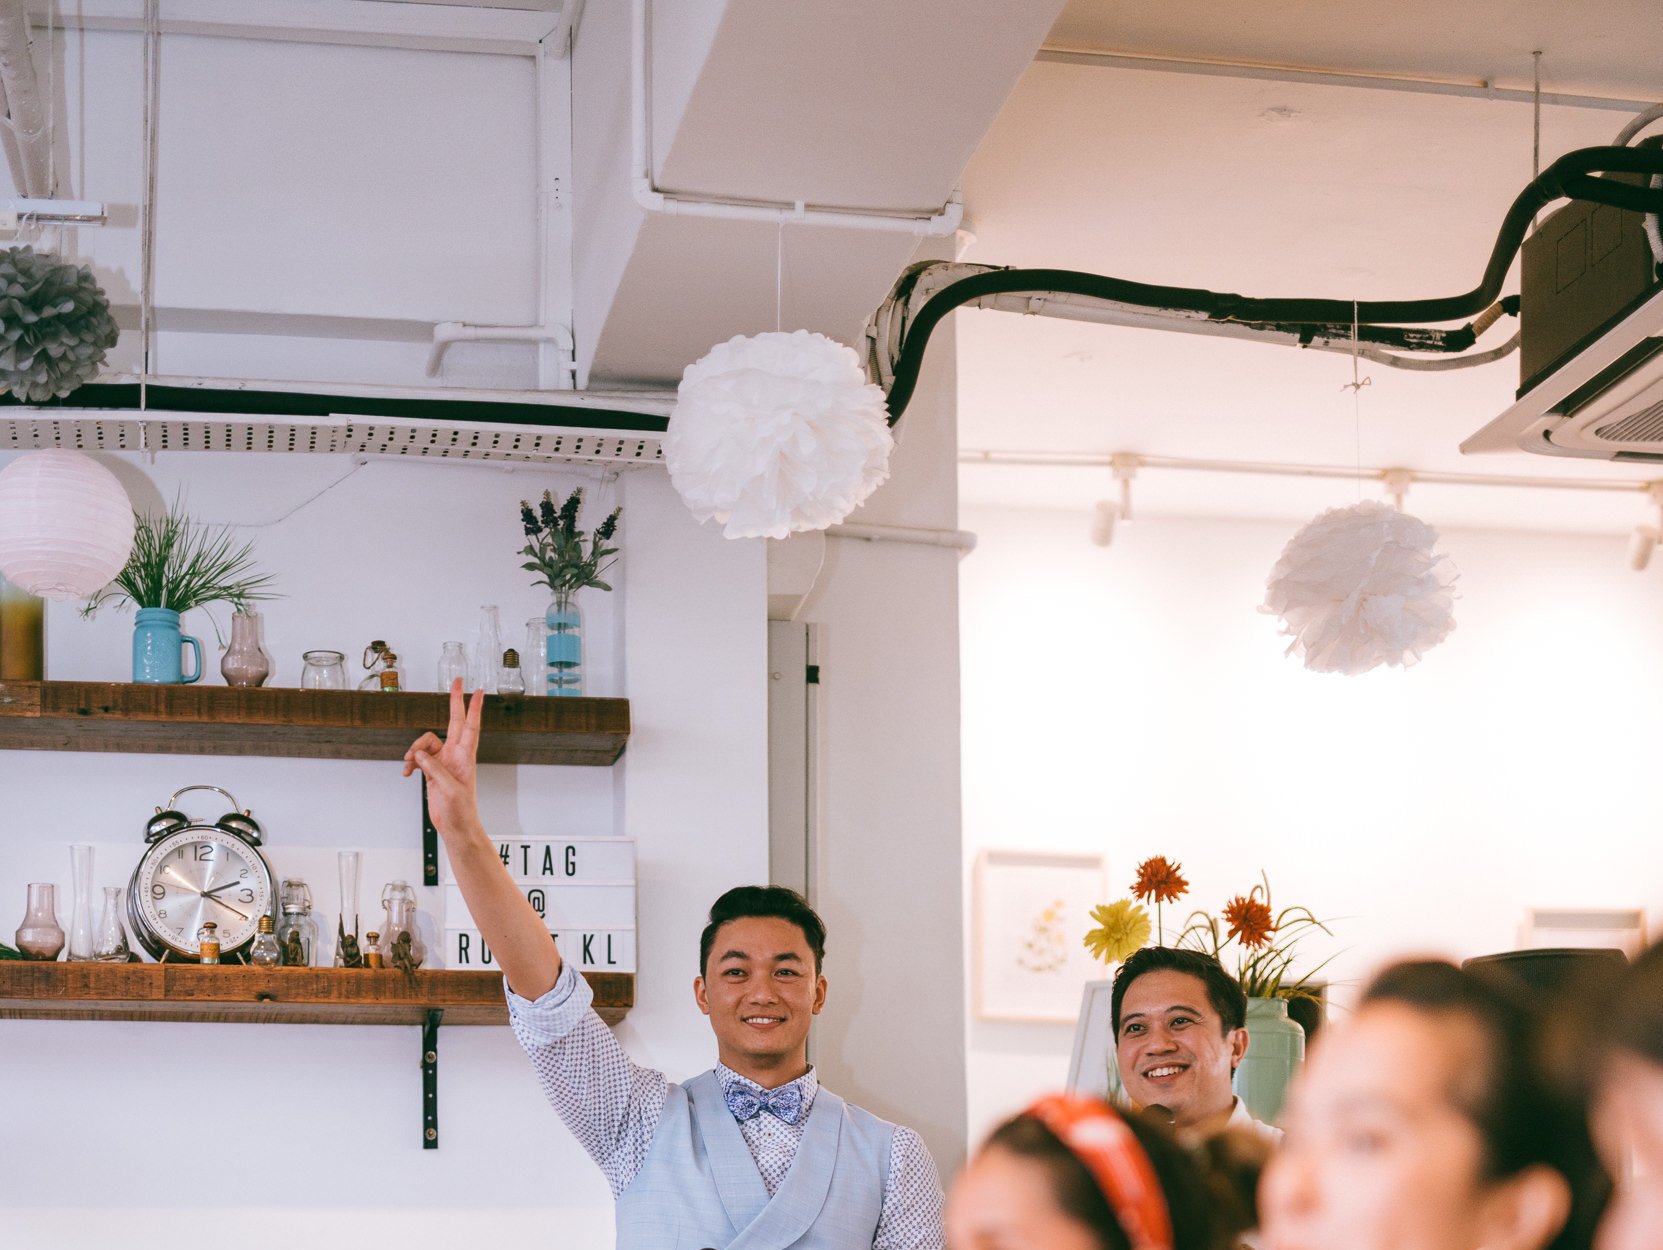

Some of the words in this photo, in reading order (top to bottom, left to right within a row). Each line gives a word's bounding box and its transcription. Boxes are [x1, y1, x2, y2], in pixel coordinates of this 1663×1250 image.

[194, 845, 214, 861] 12
[240, 869, 249, 878] 2
[152, 884, 165, 900] 9
[238, 888, 254, 903] 3
[528, 888, 545, 918] @
[158, 909, 168, 918] 8
[176, 927, 184, 936] 7
[222, 929, 231, 938] 5
[582, 933, 617, 965] KL
